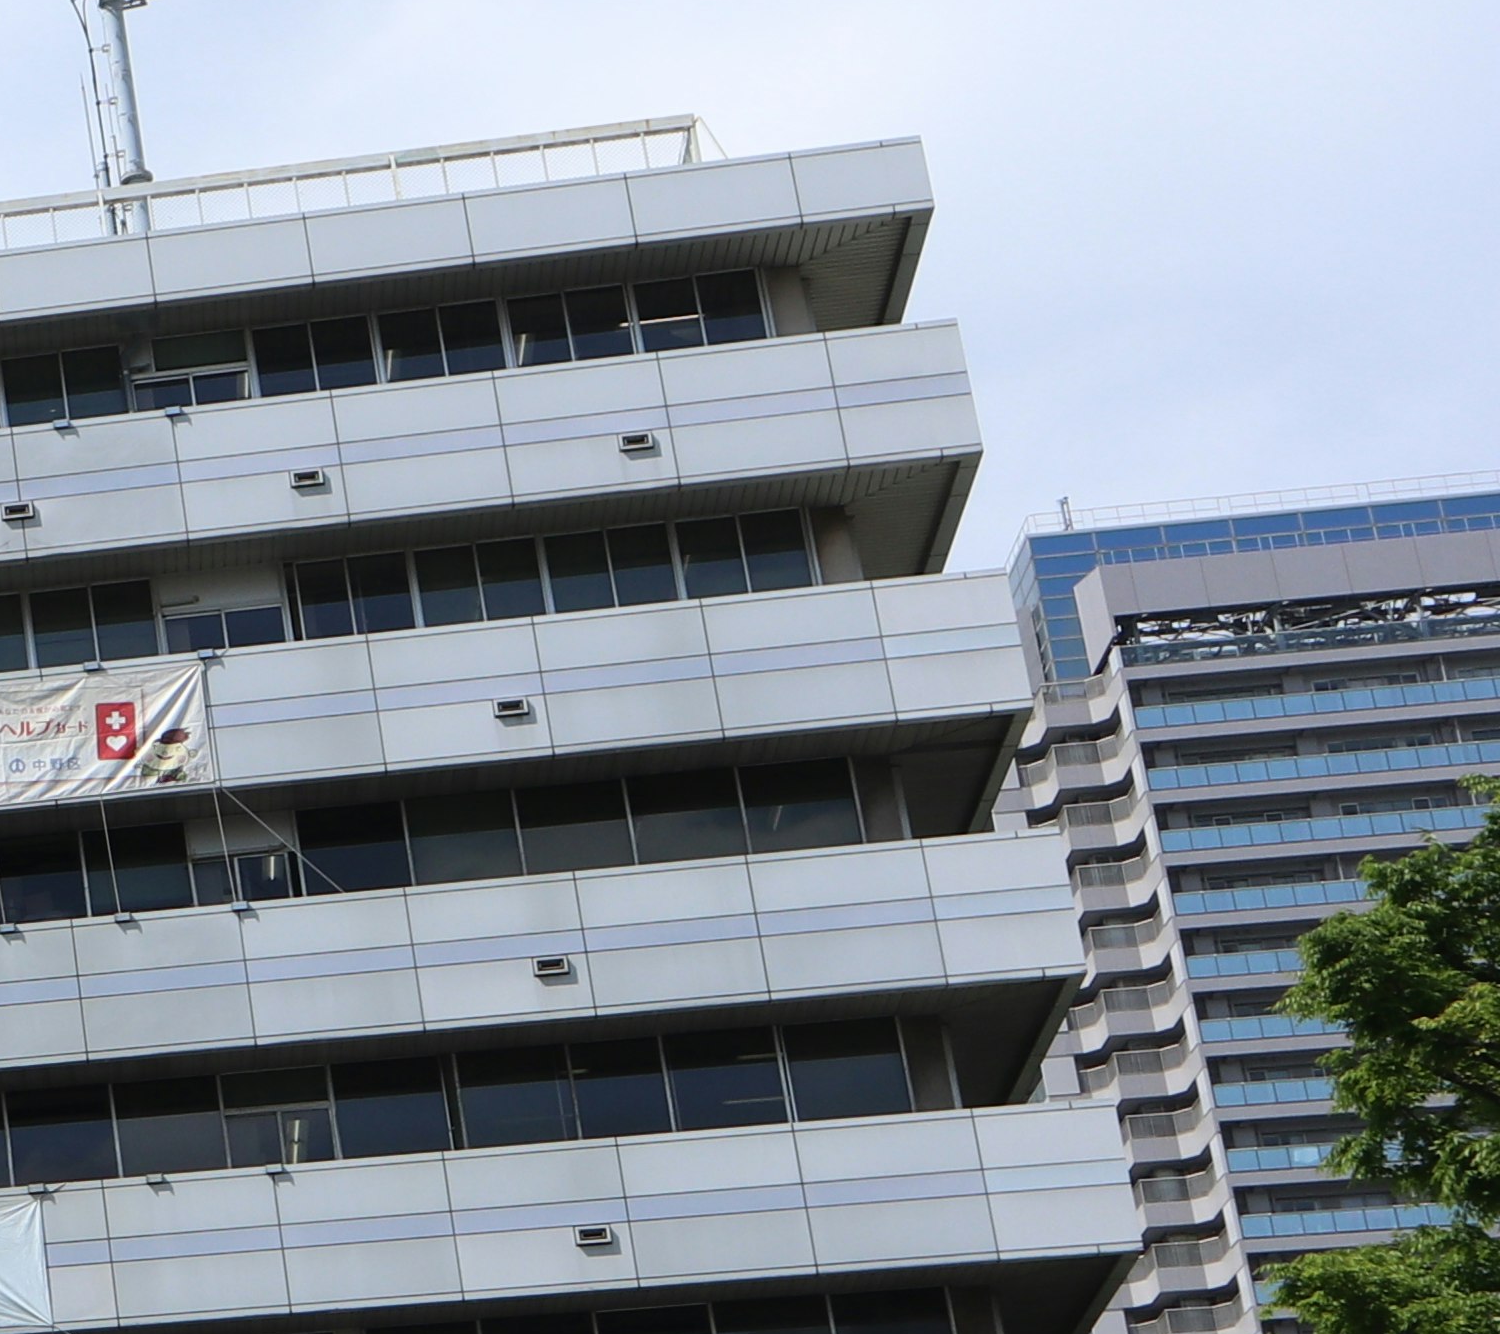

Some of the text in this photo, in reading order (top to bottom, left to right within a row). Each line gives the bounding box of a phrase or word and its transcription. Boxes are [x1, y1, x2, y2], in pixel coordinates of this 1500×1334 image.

[0, 720, 88, 737] ヘルプカード
